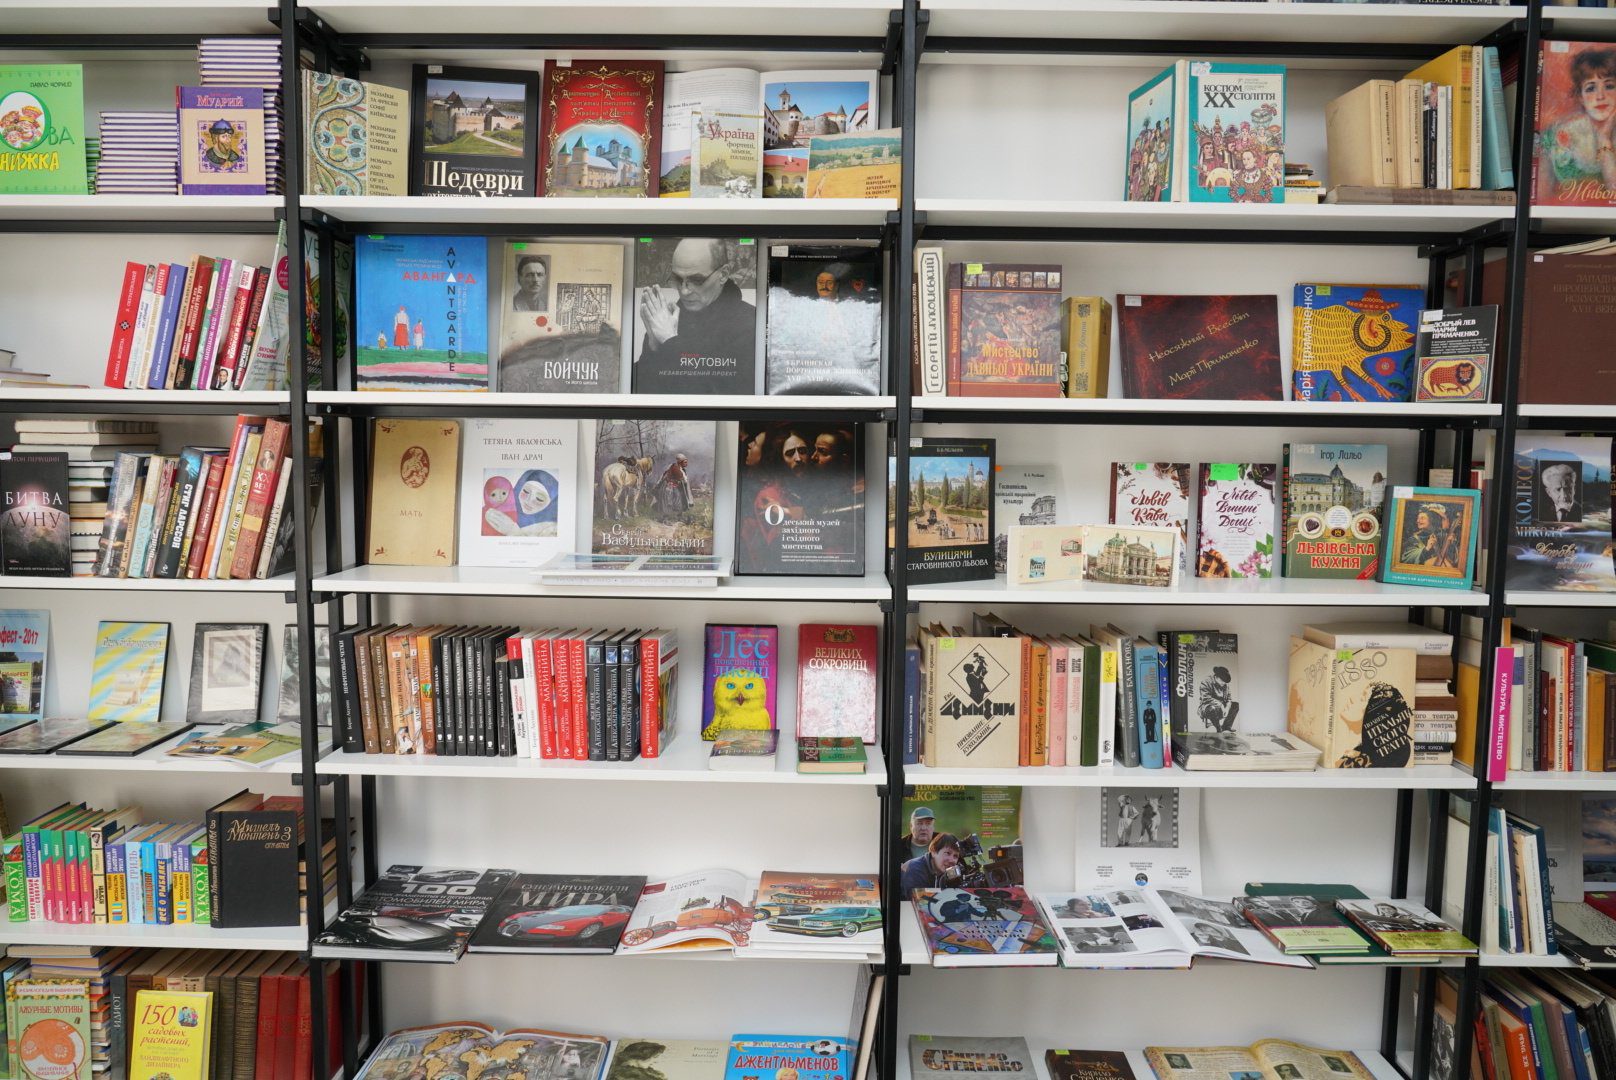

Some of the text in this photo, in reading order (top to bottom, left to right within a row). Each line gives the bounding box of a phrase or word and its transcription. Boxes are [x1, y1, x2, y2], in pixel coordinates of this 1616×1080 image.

[544, 358, 599, 381] БОЙЧУК
[680, 357, 737, 369] ЯКУТОВИЧ
[483, 438, 562, 446] ТЕТЯНА ЯБЛОНСЬКА
[501, 453, 543, 462] ІВАН ДРАЧ
[1320, 449, 1334, 460] Ігор
[5, 491, 63, 506] БИТВА
[1131, 489, 1171, 506] Львів
[5, 511, 62, 529] ЛУНУ
[172, 483, 193, 549] СТИГ ЛАРССОН
[400, 509, 423, 518] МАТЬ
[764, 503, 841, 527] Одеський музей
[1131, 508, 1170, 523] Кава
[924, 550, 972, 561] ВУЛИЦЯМИ
[1296, 542, 1375, 556] ЛЬВІВСЬКА
[906, 558, 989, 570] СТАРОВИННОГО ЛЬВОВА
[1311, 556, 1361, 569] КУХНЯ
[23, 628, 39, 645] 2017
[713, 631, 769, 659] Лес
[815, 647, 862, 659] ВЕЛИКИХ
[540, 643, 550, 702] МАРИНИНА
[559, 644, 569, 702] МАРИНИНА
[574, 644, 583, 703] МАРИНИНА
[646, 644, 656, 702] МАРИНИНА
[809, 658, 867, 672] СОКРОВИЩ
[1337, 651, 1388, 690] 1880
[610, 668, 619, 748] АЛЕКСАНДРА МАРИНИНА
[624, 667, 634, 747] АЛЕКСАНДРА МАРИНИНА
[594, 706, 602, 747] АЛЕКСАНДРА
[1373, 724, 1409, 749] СКОГО
[1496, 714, 1506, 760] МИСТЕЦТВО
[9, 865, 21, 917] ДОМА
[401, 883, 477, 896] 100
[513, 892, 619, 907] МИРА
[19, 1005, 84, 1014] АЖУРНЫЕ МОТИВЫ
[113, 995, 121, 1028] ИДИОТ
[141, 1004, 177, 1026] 150
[148, 1027, 186, 1037] садовых
[140, 1036, 191, 1047] растений,
[735, 1055, 839, 1071] ДЖЕНТЛЬМЕНОВ
